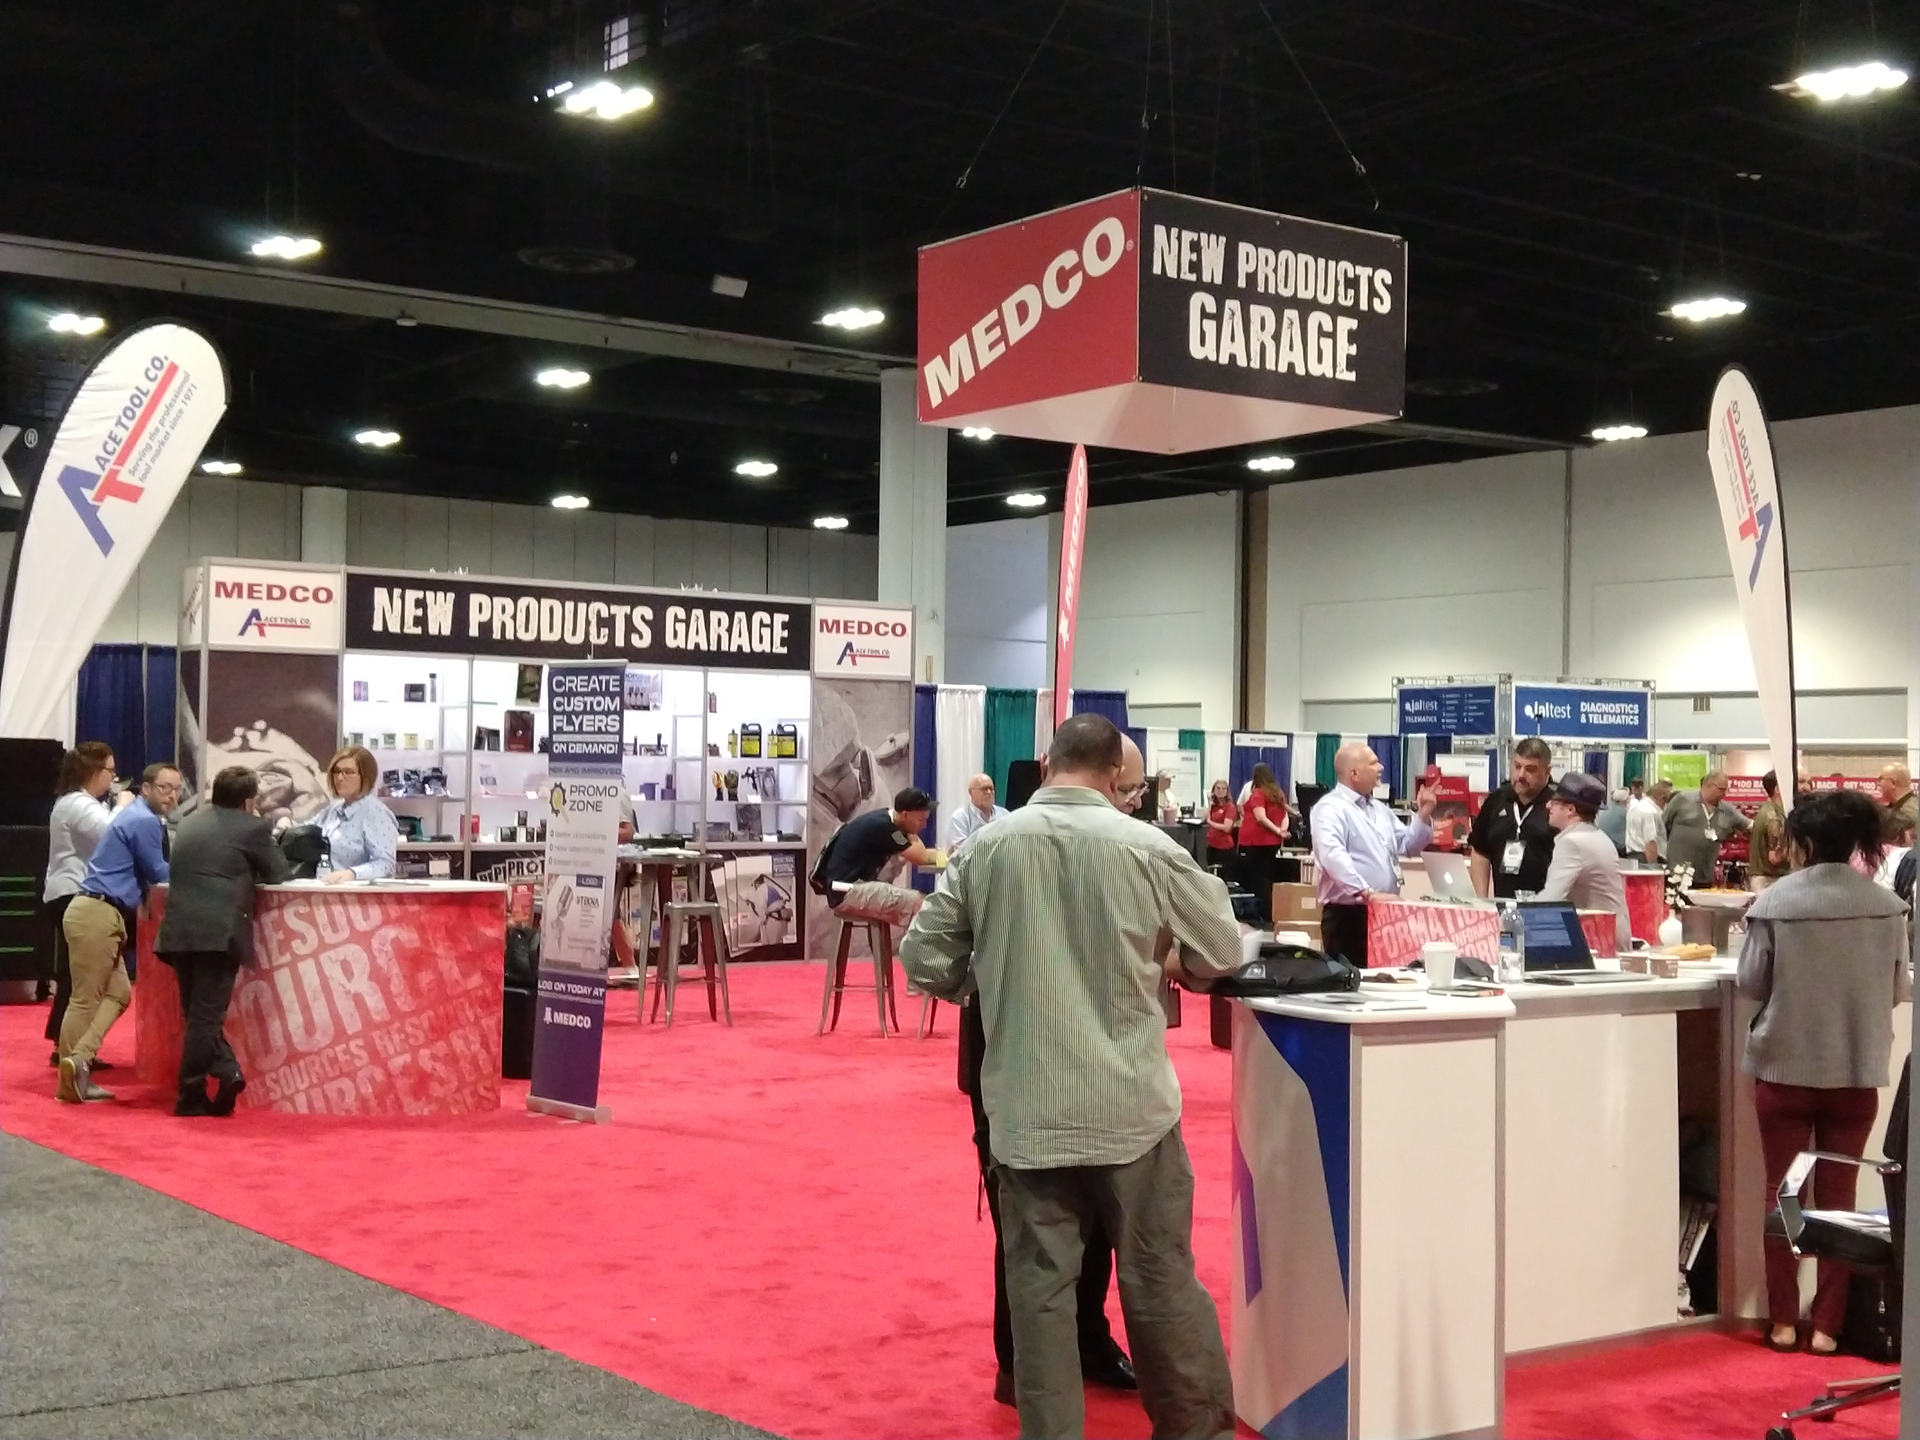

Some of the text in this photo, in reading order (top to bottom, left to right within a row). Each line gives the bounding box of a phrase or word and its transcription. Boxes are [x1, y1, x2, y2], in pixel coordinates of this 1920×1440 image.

[1152, 224, 1393, 315] NEW PRODUCTS
[923, 216, 1125, 409] MEDCO
[1188, 291, 1359, 382] GARAGE
[94, 431, 124, 473] ACE
[114, 385, 152, 432] TOOL
[128, 369, 192, 478] Serving the professional
[137, 382, 199, 484] tool market since 1971
[214, 580, 334, 605] MEDCO
[372, 587, 789, 654] NEW PRODUCTS GARAGE
[818, 618, 907, 637] MEDCO
[552, 674, 621, 693] CREATE
[552, 696, 620, 712] CUSTOM
[1580, 701, 1639, 714] DIAGNOSTICS
[552, 714, 620, 734] FLYERS
[1580, 713, 1639, 725] & TELEMATICS
[552, 743, 618, 755] ON DEMAND!
[581, 767, 622, 775] IMPROVED
[569, 784, 619, 798] PROMO
[568, 799, 603, 813] ZONE
[554, 982, 565, 992] ON
[566, 983, 591, 996] TODAY
[593, 987, 605, 997] AT
[554, 1012, 592, 1030] MEDCO
